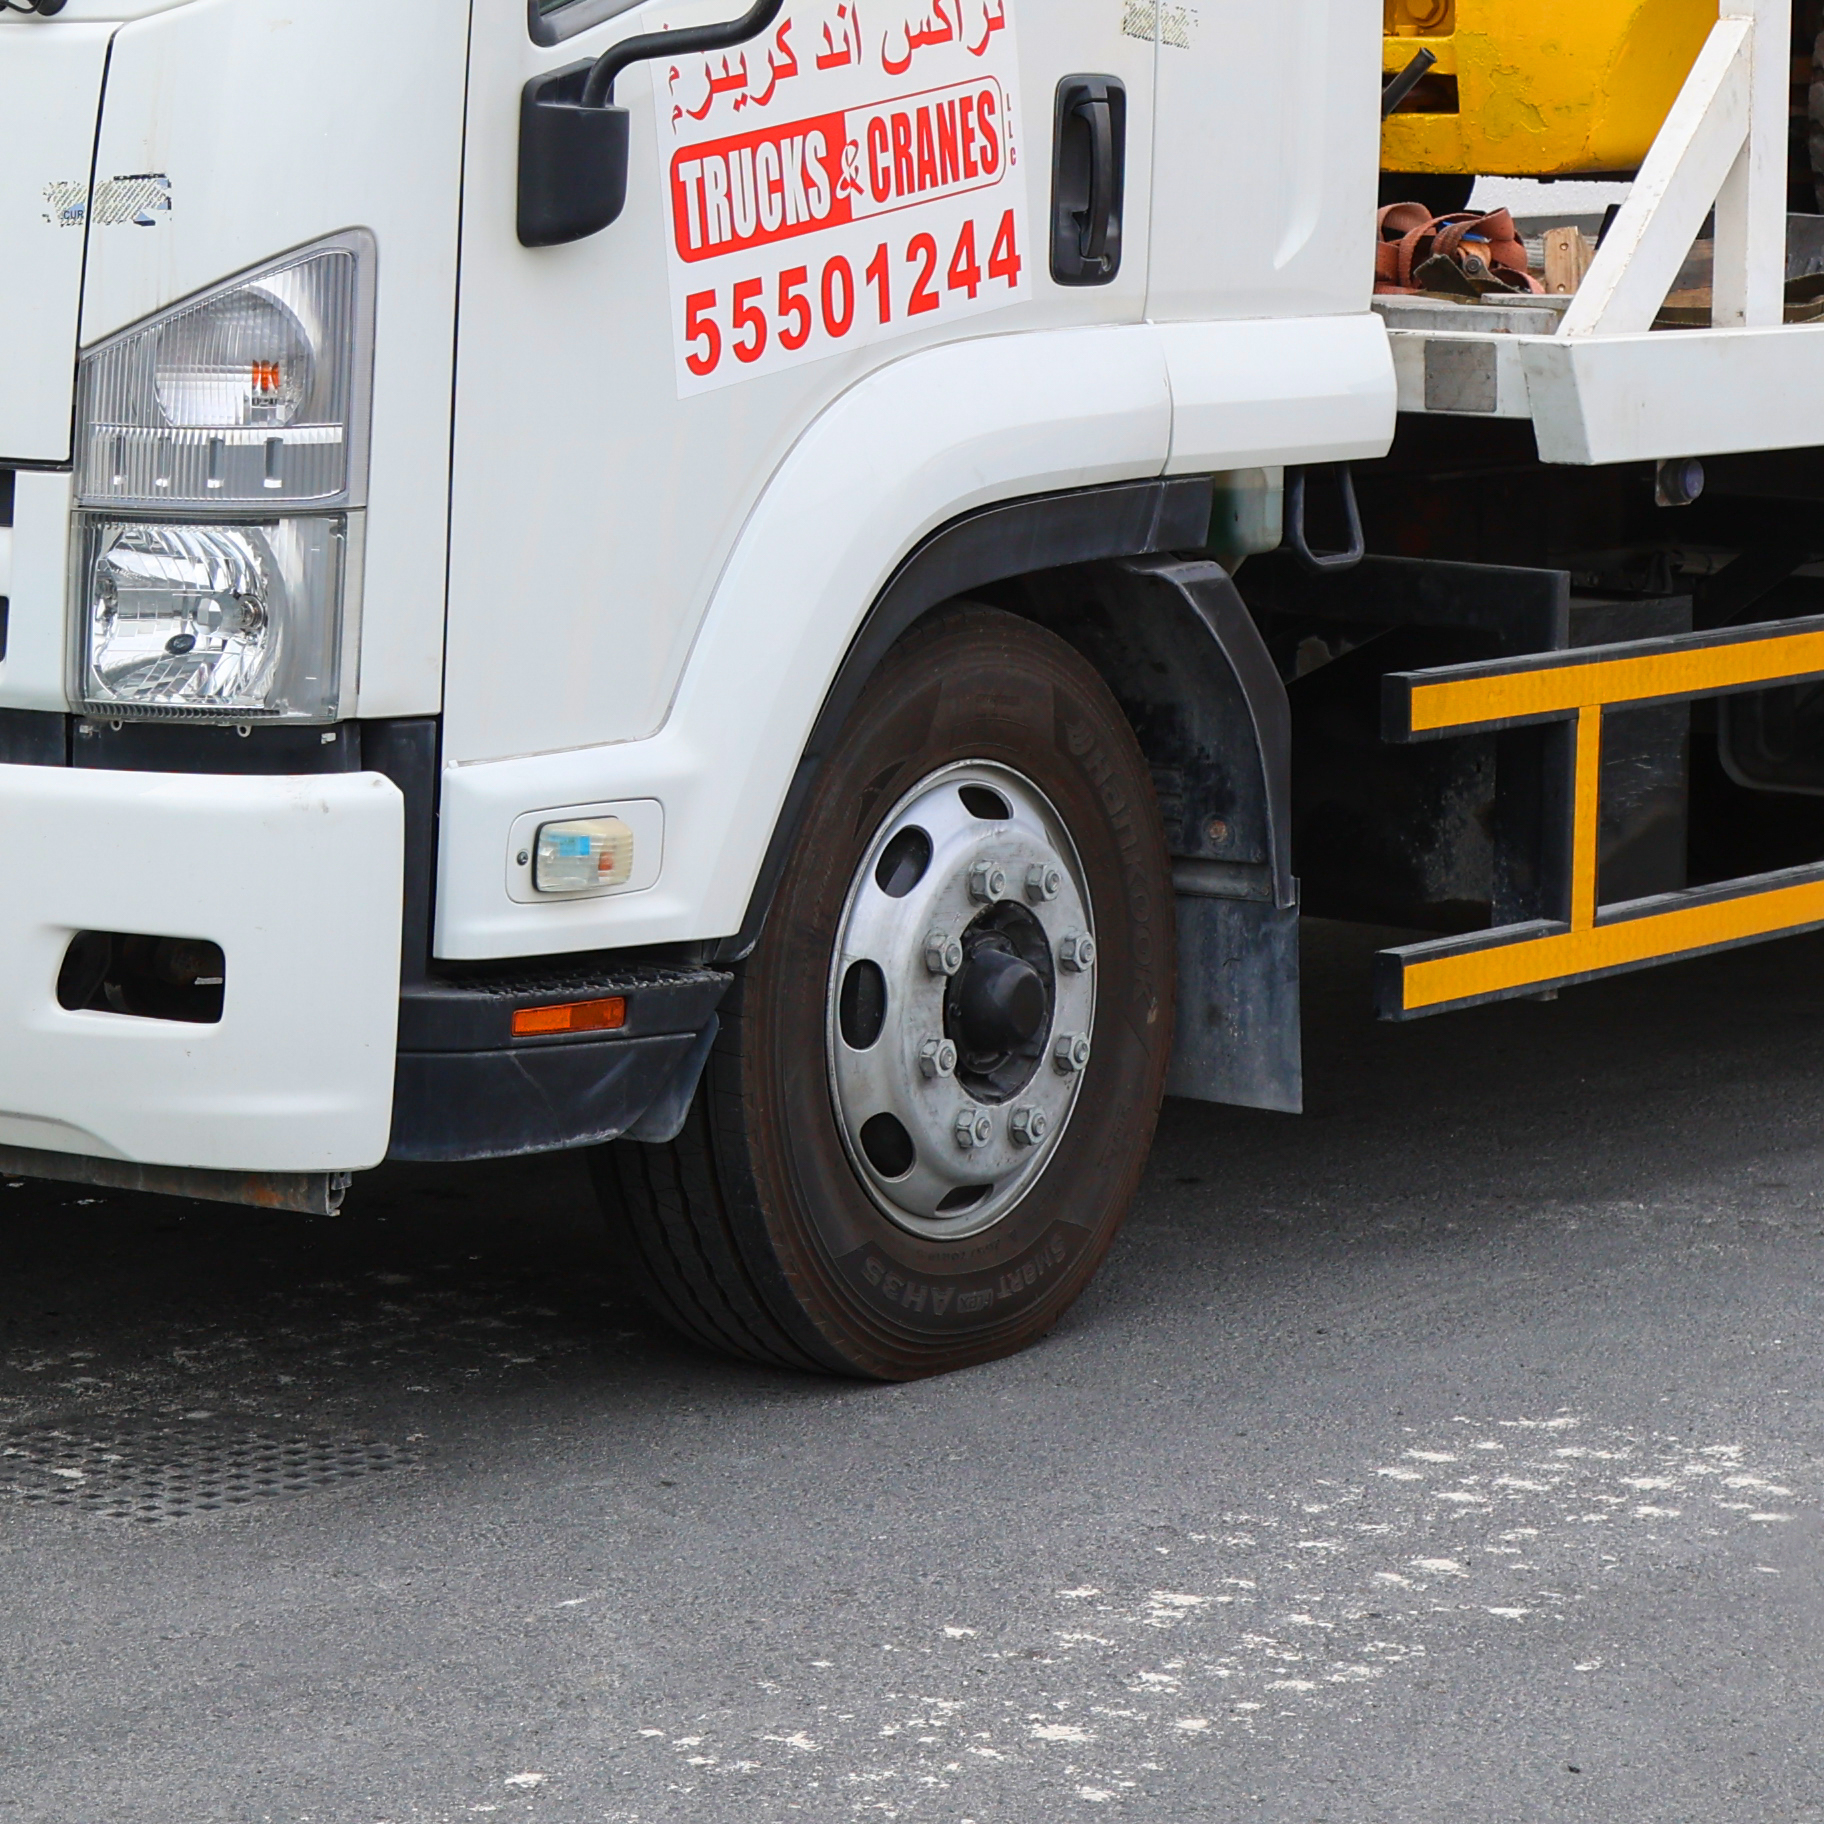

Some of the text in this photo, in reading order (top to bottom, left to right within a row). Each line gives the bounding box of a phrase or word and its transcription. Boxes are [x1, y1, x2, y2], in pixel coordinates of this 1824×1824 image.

[678, 89, 1001, 251] TRUCKS & CRANES
[684, 207, 1022, 377] 55501244
[860, 1256, 957, 1316] AH35
